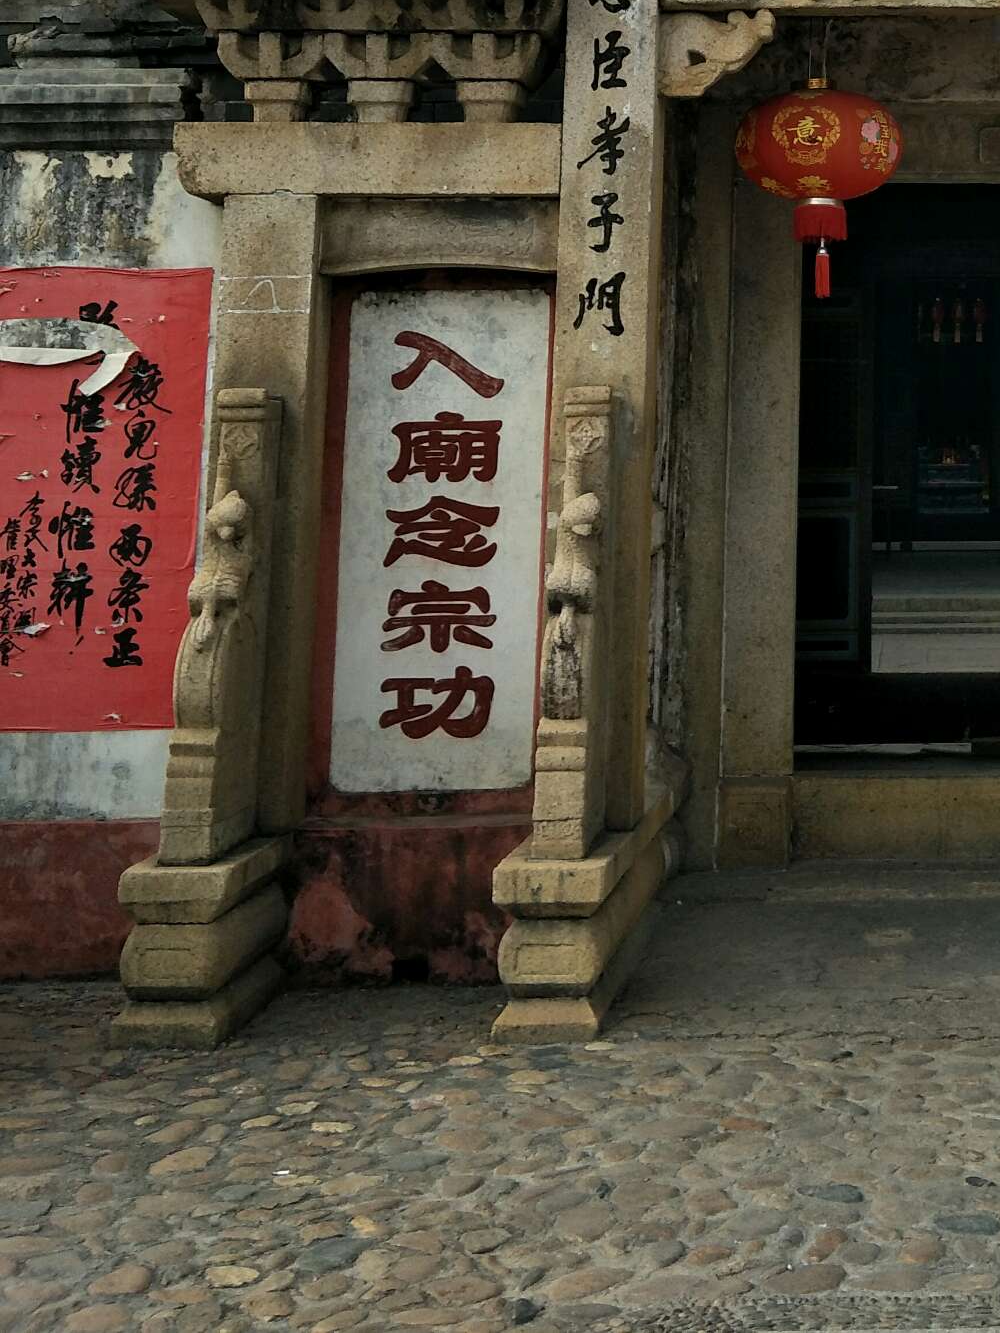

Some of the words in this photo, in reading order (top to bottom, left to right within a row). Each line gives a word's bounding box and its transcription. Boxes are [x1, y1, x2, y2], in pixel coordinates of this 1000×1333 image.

[787, 116, 823, 146] 意
[378, 330, 505, 739] 入廟念宗功
